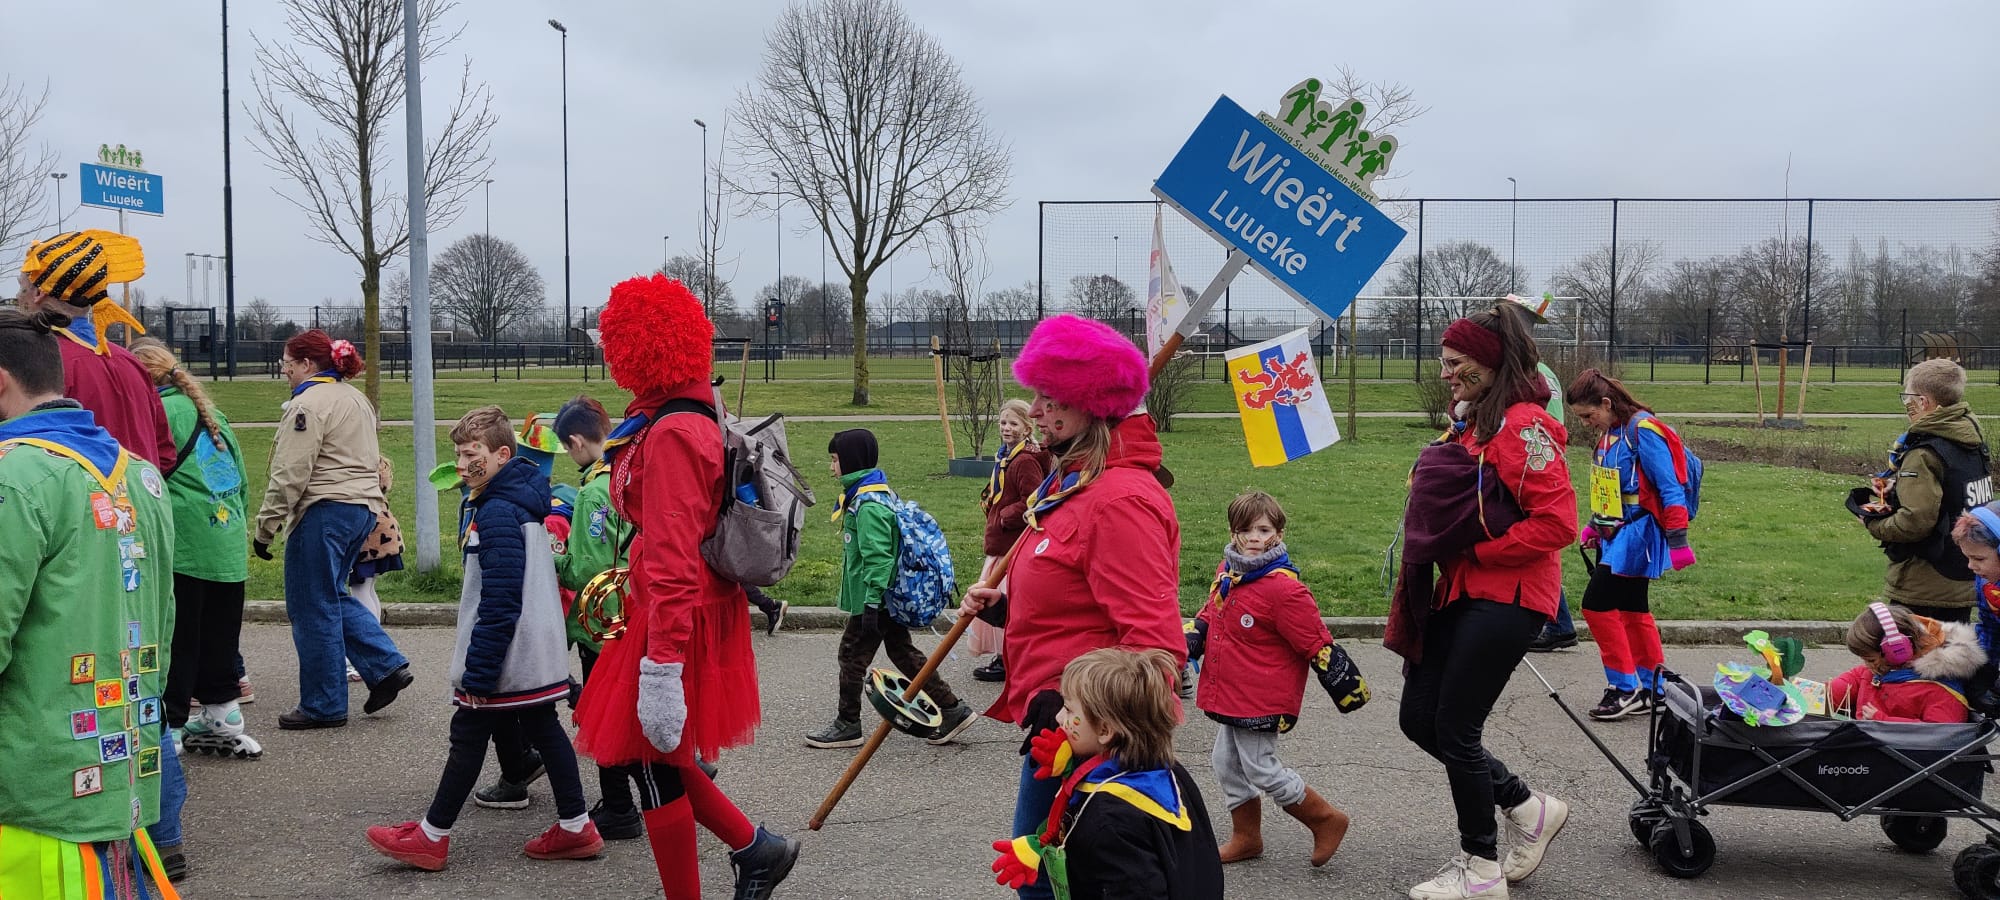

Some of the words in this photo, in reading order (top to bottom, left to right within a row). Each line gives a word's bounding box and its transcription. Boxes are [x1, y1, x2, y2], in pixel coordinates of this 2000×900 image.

[94, 168, 151, 193] Wieërt
[1259, 113, 1294, 143] Scouting
[1293, 140, 1304, 152] St.
[1303, 148, 1320, 162] Job
[1319, 158, 1375, 203] Leuken-Weert
[102, 191, 145, 208] Luueke
[1227, 128, 1364, 253] Wieërt
[1207, 189, 1308, 275] Luueke
[1818, 764, 1870, 777] lifegoods
